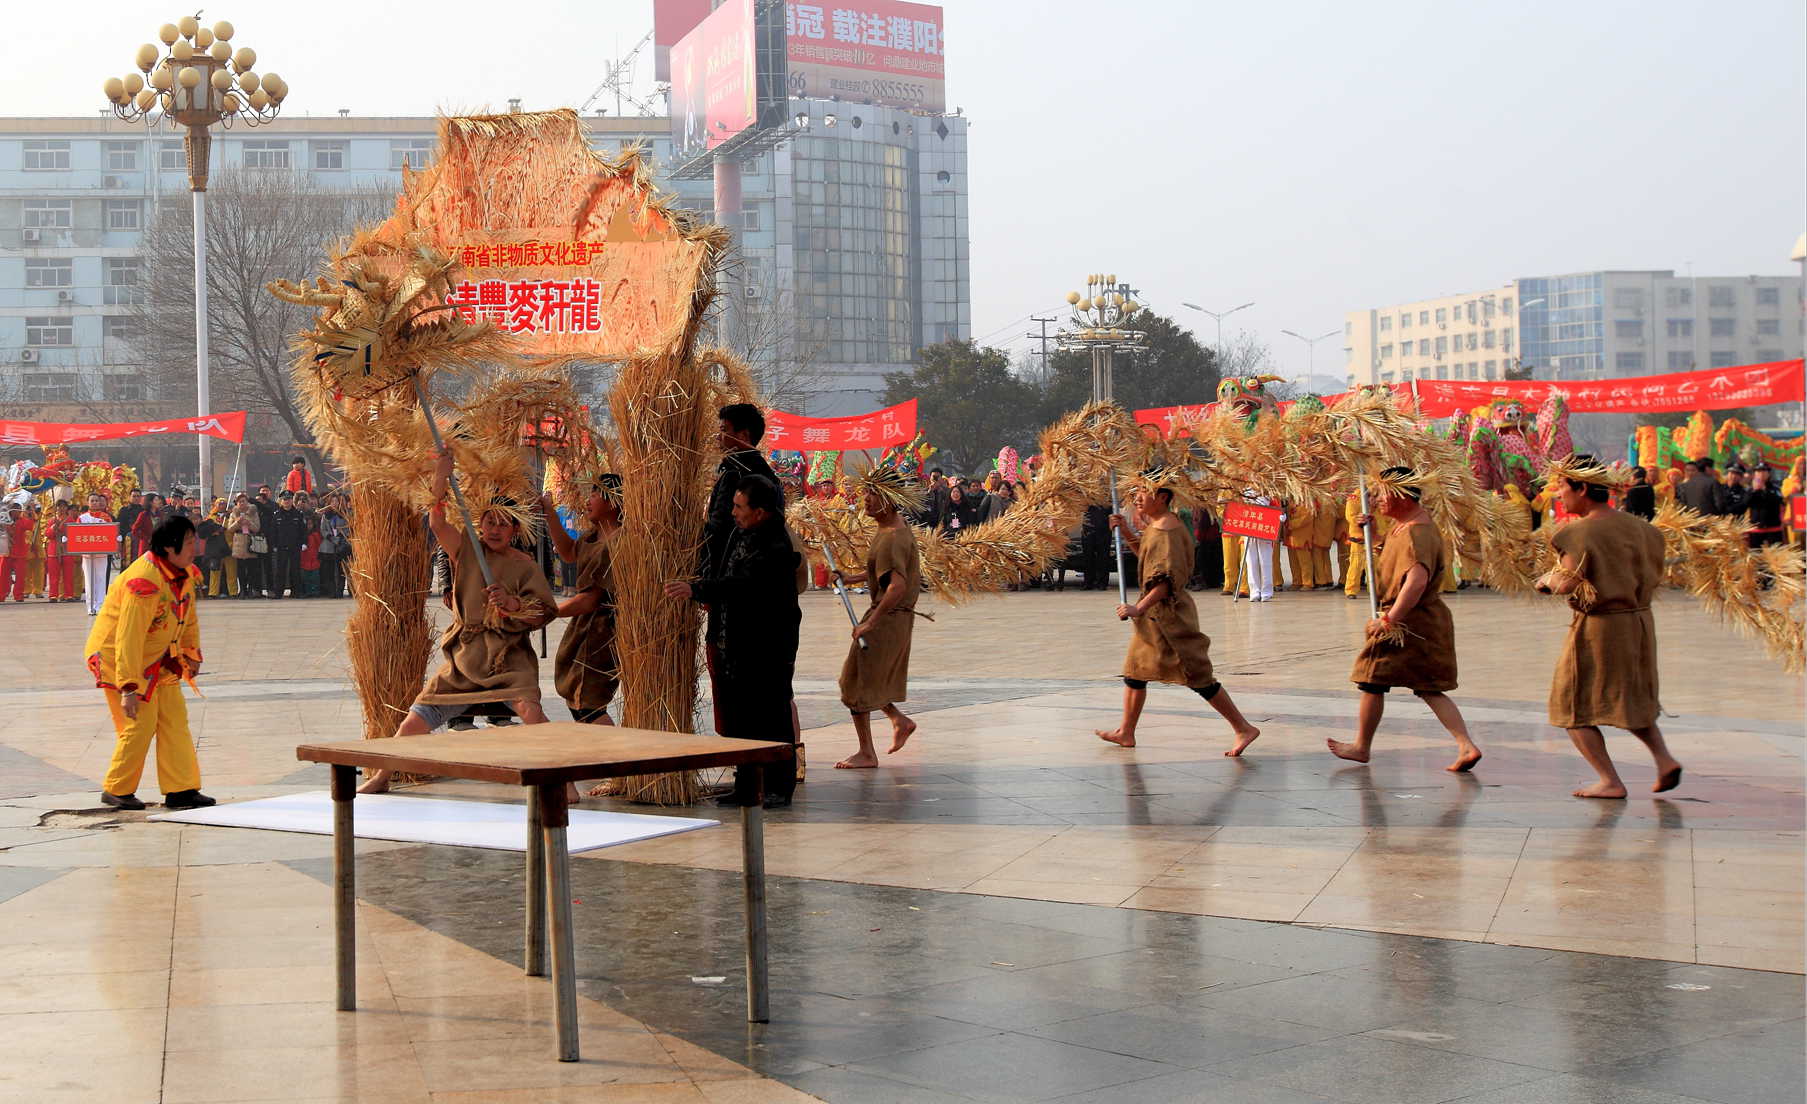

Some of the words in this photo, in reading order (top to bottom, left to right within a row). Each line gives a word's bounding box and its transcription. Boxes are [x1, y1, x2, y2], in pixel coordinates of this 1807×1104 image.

[446, 241, 604, 268] 南省非物质文化遗产
